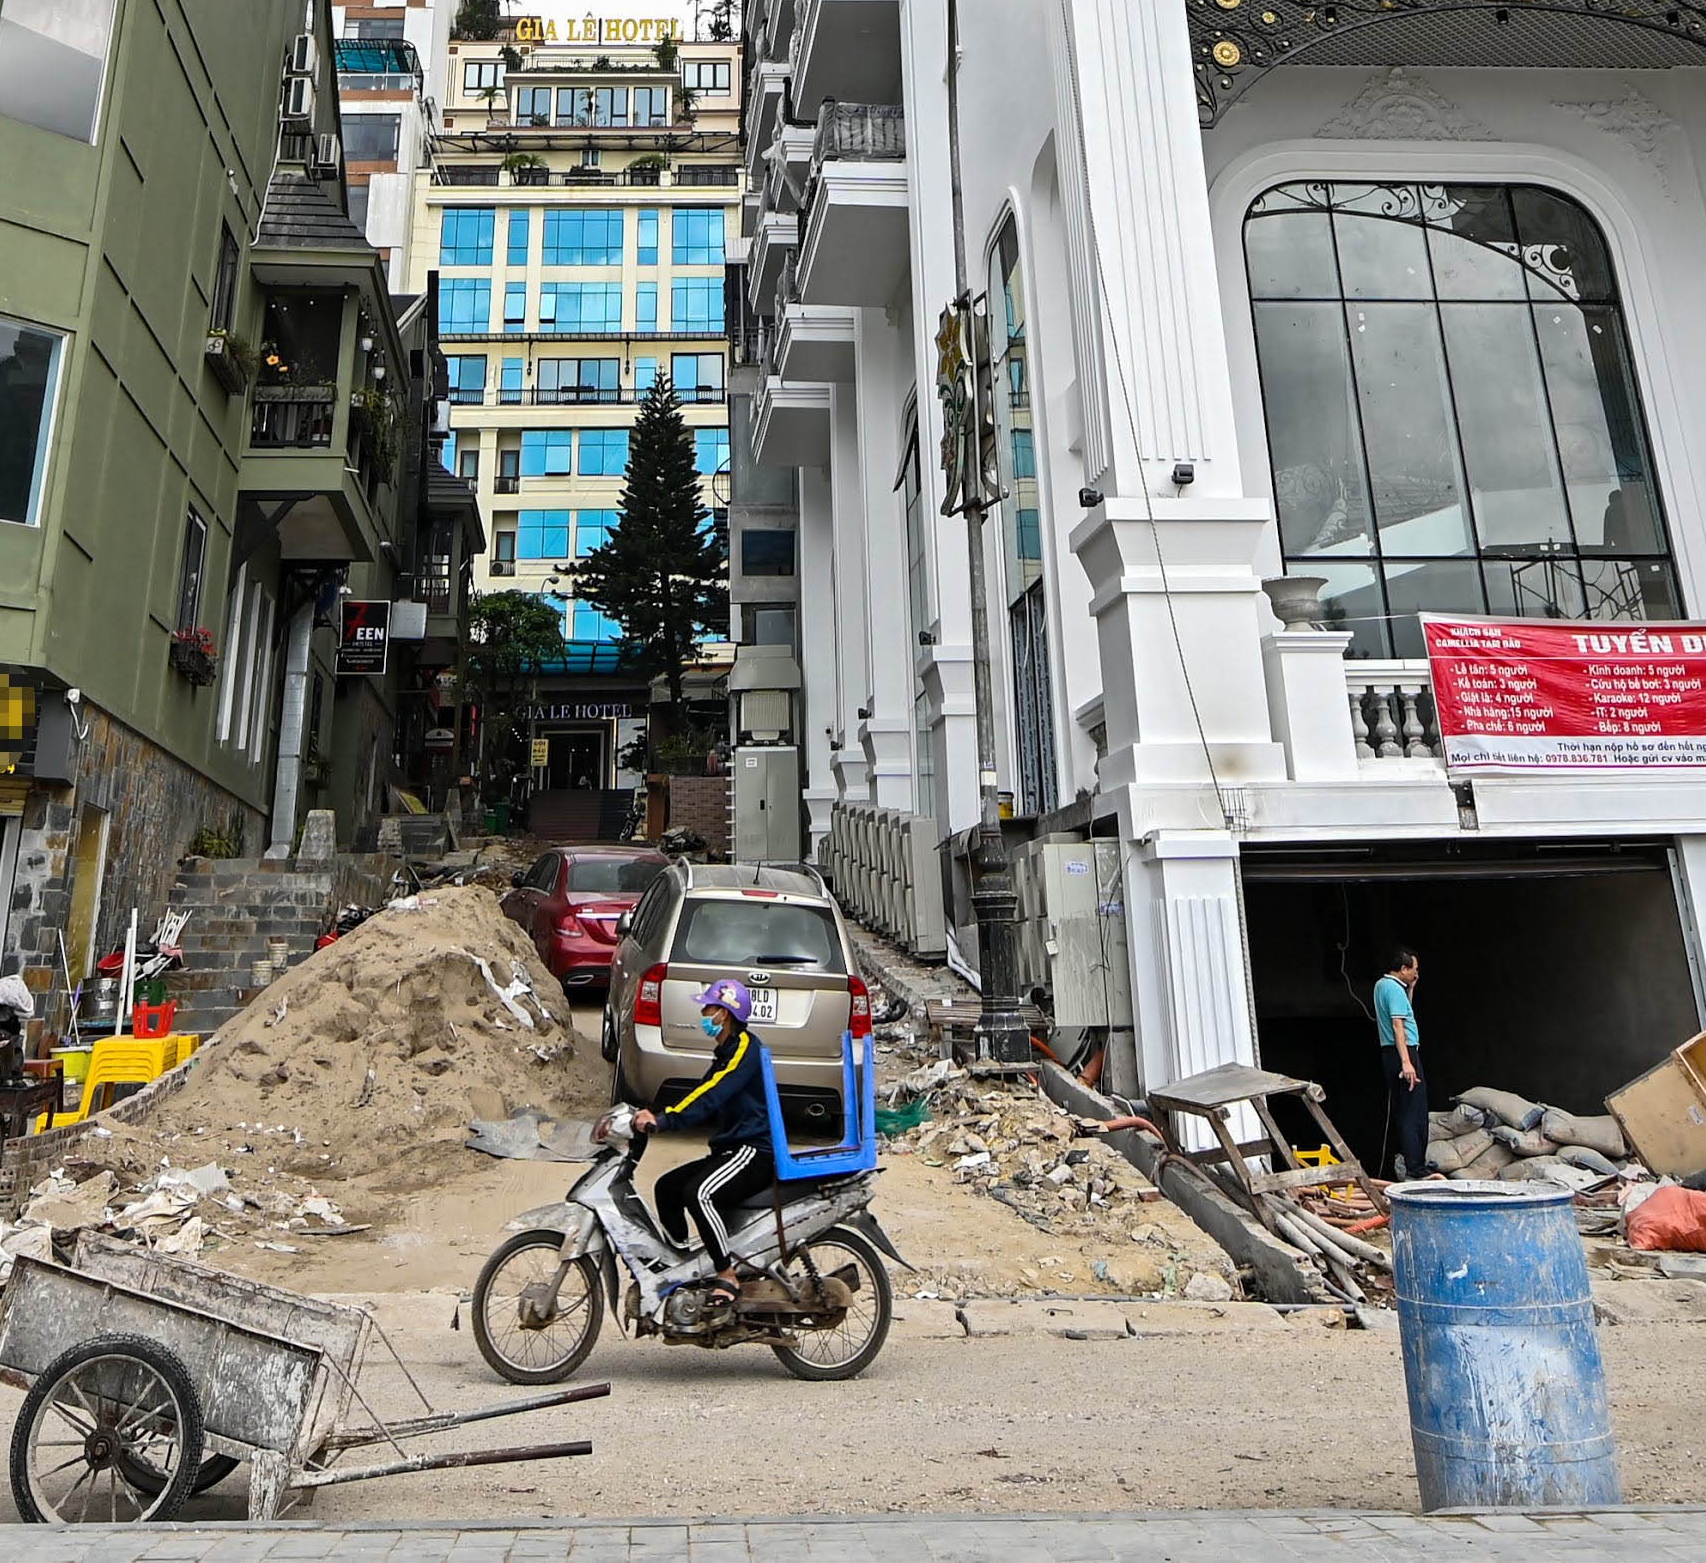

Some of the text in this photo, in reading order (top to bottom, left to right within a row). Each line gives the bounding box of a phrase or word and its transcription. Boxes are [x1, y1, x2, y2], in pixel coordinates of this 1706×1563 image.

[516, 11, 684, 42] GIA LÊ HOTEL
[1571, 628, 1674, 653] TUYỂN
[1490, 665, 1496, 675] 5
[1498, 665, 1528, 677] người
[1613, 665, 1646, 675] doanh:
[1648, 665, 1654, 675] 5
[1656, 665, 1685, 677] người
[1472, 678, 1497, 689] toán:
[1500, 679, 1506, 689] 3
[1508, 679, 1537, 691] người
[1614, 679, 1626, 692] hộ
[1642, 679, 1661, 689] bơi:
[1664, 679, 1670, 689] 3
[1672, 679, 1701, 691] người
[1495, 693, 1501, 703] 4
[1504, 693, 1534, 705] người
[1639, 694, 1650, 703] 12
[1652, 693, 1681, 705] người
[576, 704, 632, 718] HOTEL
[1524, 707, 1554, 719] người
[1610, 707, 1616, 717] 2
[1618, 707, 1648, 719] người
[1508, 722, 1514, 731] 6
[1516, 722, 1546, 734] người
[1624, 722, 1629, 731] 8
[1632, 722, 1661, 734] người
[1557, 742, 1580, 752] Thời
[1583, 743, 1601, 752] hạn
[1604, 743, 1623, 754] nộp
[1626, 741, 1639, 751] hồ
[1657, 741, 1674, 751] đến
[1678, 741, 1693, 751] hết
[1451, 753, 1471, 763] Mọi
[1474, 753, 1490, 761] chi
[1508, 753, 1525, 762] liên
[1546, 754, 1608, 763] 0978.836.781
[1614, 754, 1639, 764] Hoặc
[1642, 753, 1659, 764] gửi
[1662, 754, 1673, 762] cv
[1674, 753, 1693, 762] vào
